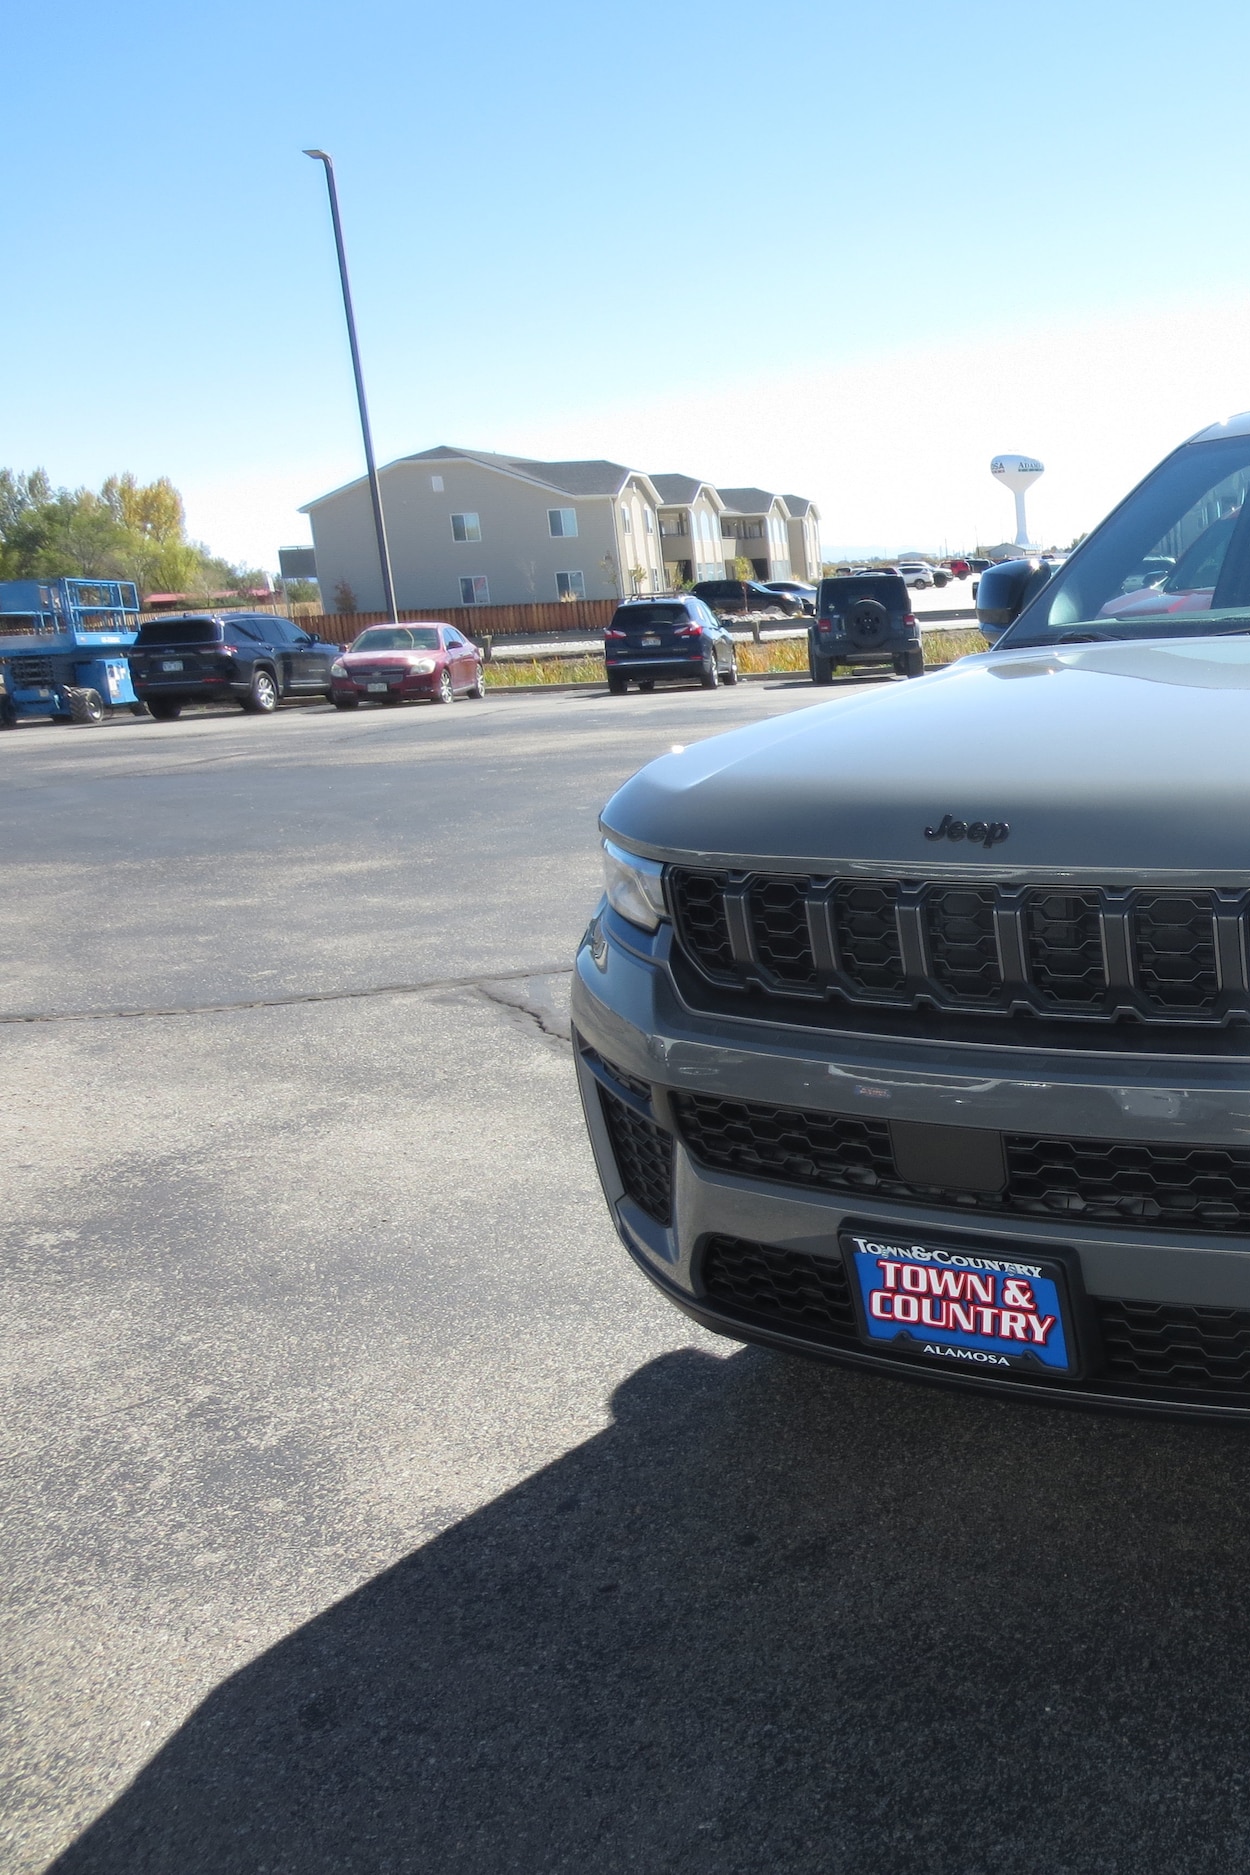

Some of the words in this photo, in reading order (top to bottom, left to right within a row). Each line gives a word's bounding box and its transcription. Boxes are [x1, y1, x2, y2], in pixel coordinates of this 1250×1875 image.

[923, 813, 1010, 849] Jeep
[877, 1259, 995, 1305] TOWN
[1002, 1278, 1037, 1310] &
[869, 1289, 1056, 1345] COUNTRY
[923, 1344, 1011, 1367] ALAMOSA
